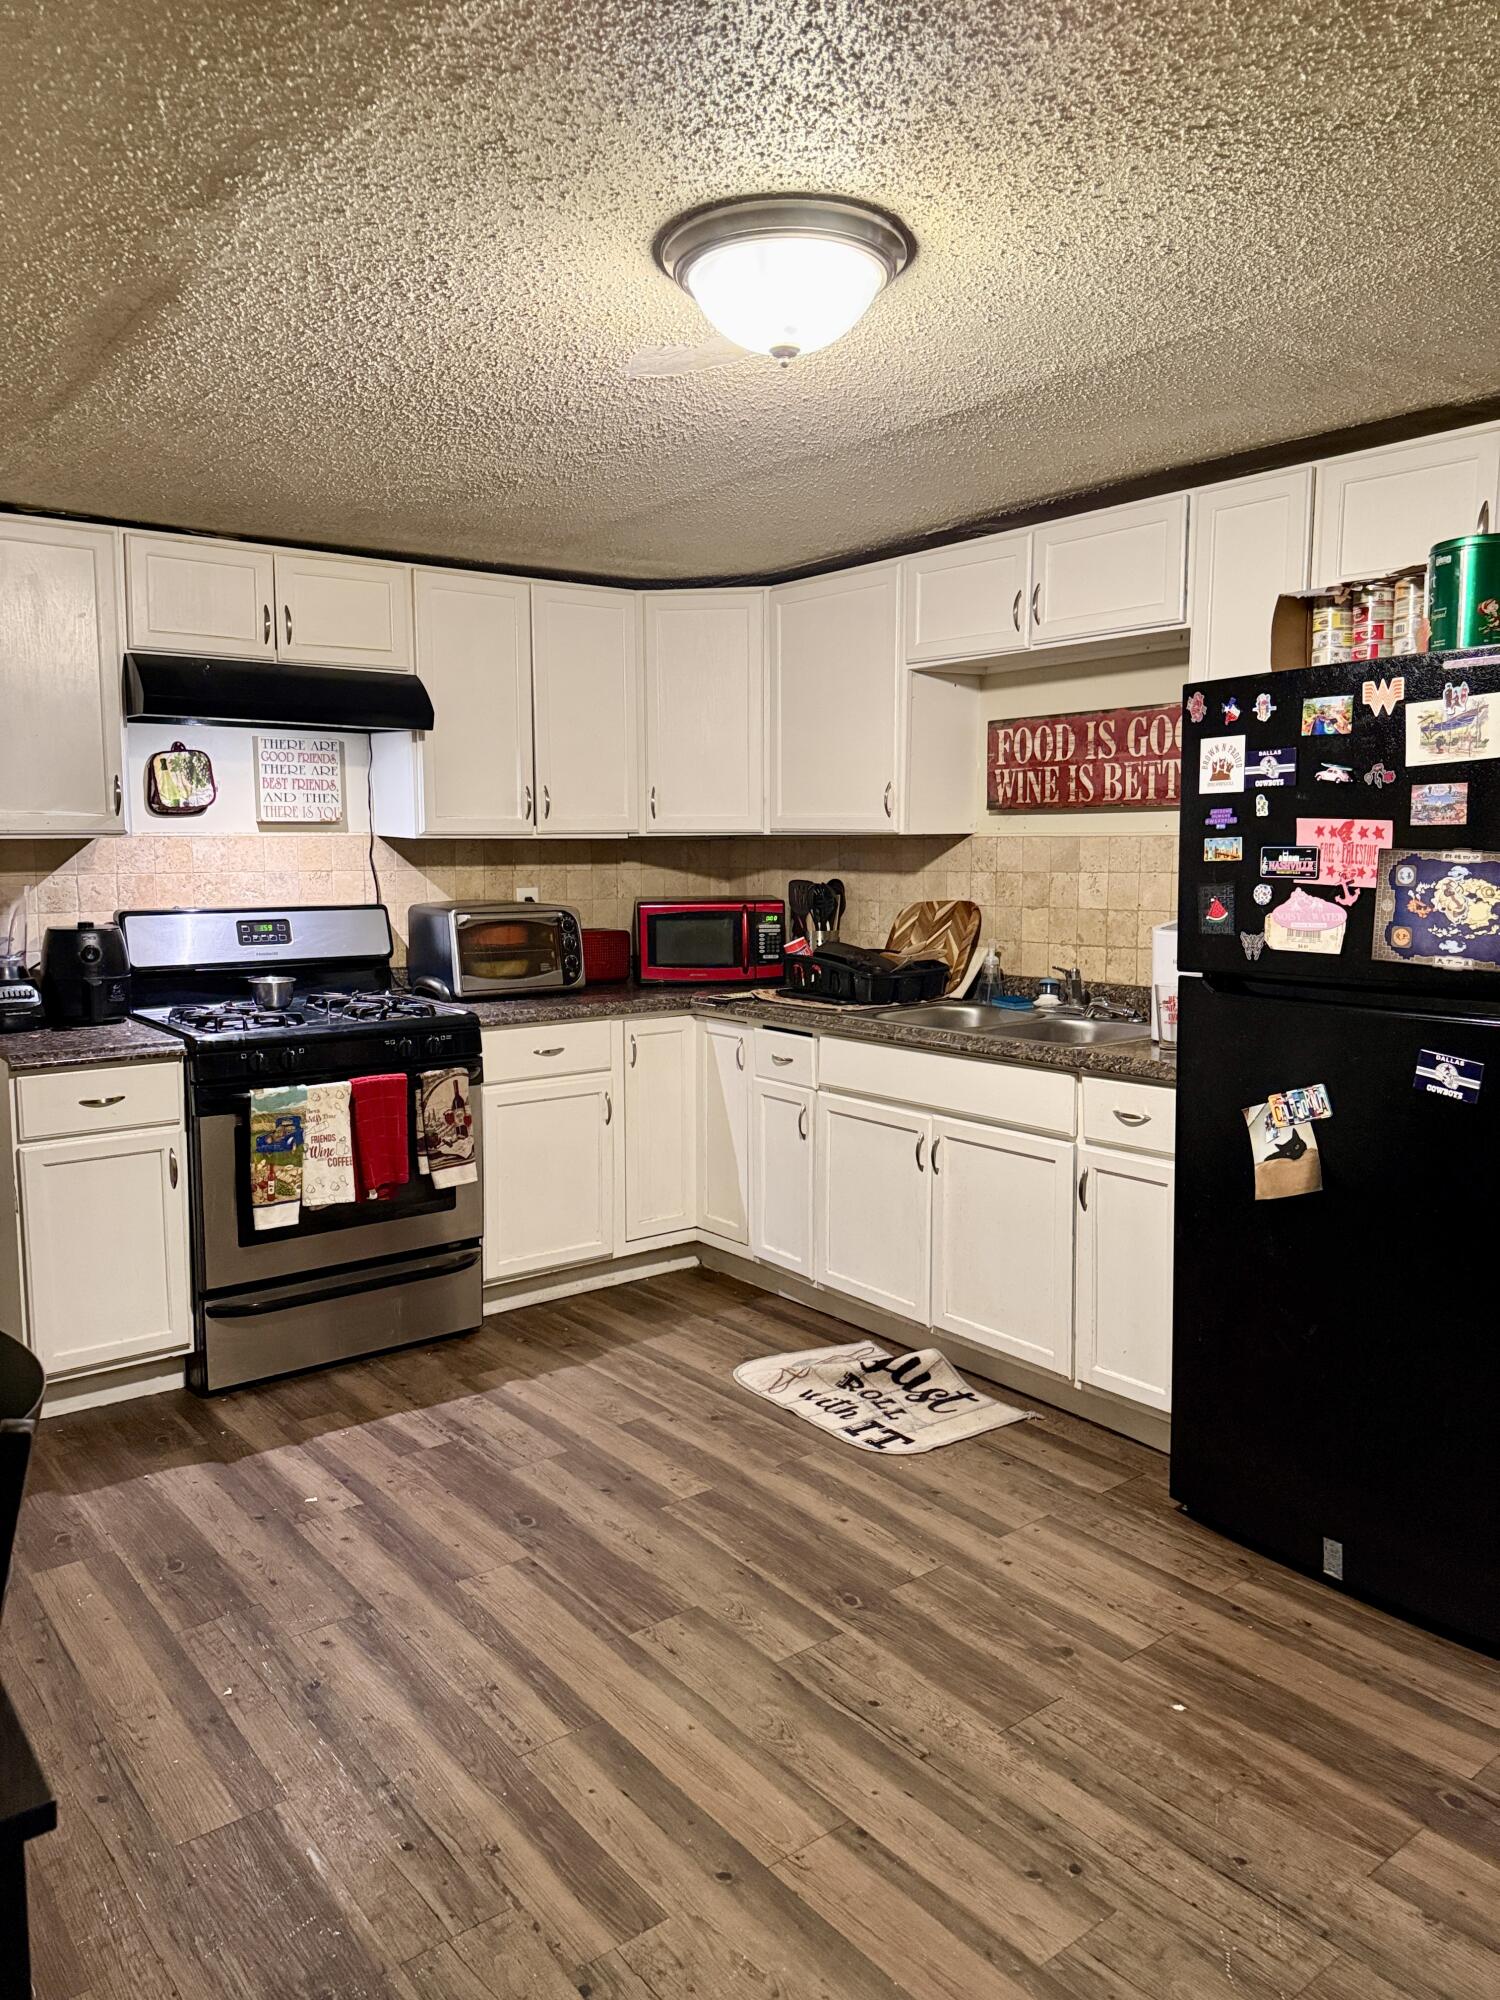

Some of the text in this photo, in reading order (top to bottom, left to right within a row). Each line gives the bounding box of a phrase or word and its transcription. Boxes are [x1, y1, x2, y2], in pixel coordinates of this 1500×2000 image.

[261, 738, 338, 752] THERE ARE
[996, 723, 1076, 766] FOOD
[1085, 719, 1117, 760] IS
[261, 751, 339, 765] GOOD FRIENDS,
[1201, 743, 1220, 770] BROWN
[1228, 745, 1243, 768] PROUD
[1258, 749, 1282, 757] DALLAS
[261, 763, 338, 776] THERE ARE
[262, 777, 339, 792] BEST FRIENDS,
[994, 765, 1060, 805] WINE
[1068, 763, 1094, 803] IS
[1255, 779, 1284, 787] COWBOYS
[264, 792, 340, 804] AND THEN
[263, 805, 341, 819] THERE IS YOU
[1320, 841, 1378, 866] FREE PALESTINE
[1268, 860, 1314, 871] NASHVILLE
[1276, 909, 1345, 922] NOISY WATER
[1435, 1054, 1465, 1067] DALLAS
[1426, 1084, 1464, 1100] COWBOYS
[1274, 1088, 1328, 1122] CALIFORNIA
[310, 1134, 337, 1144] FRIENDS
[309, 1143, 335, 1159] Wine
[798, 1388, 858, 1421] with
[843, 1419, 916, 1450] IT
